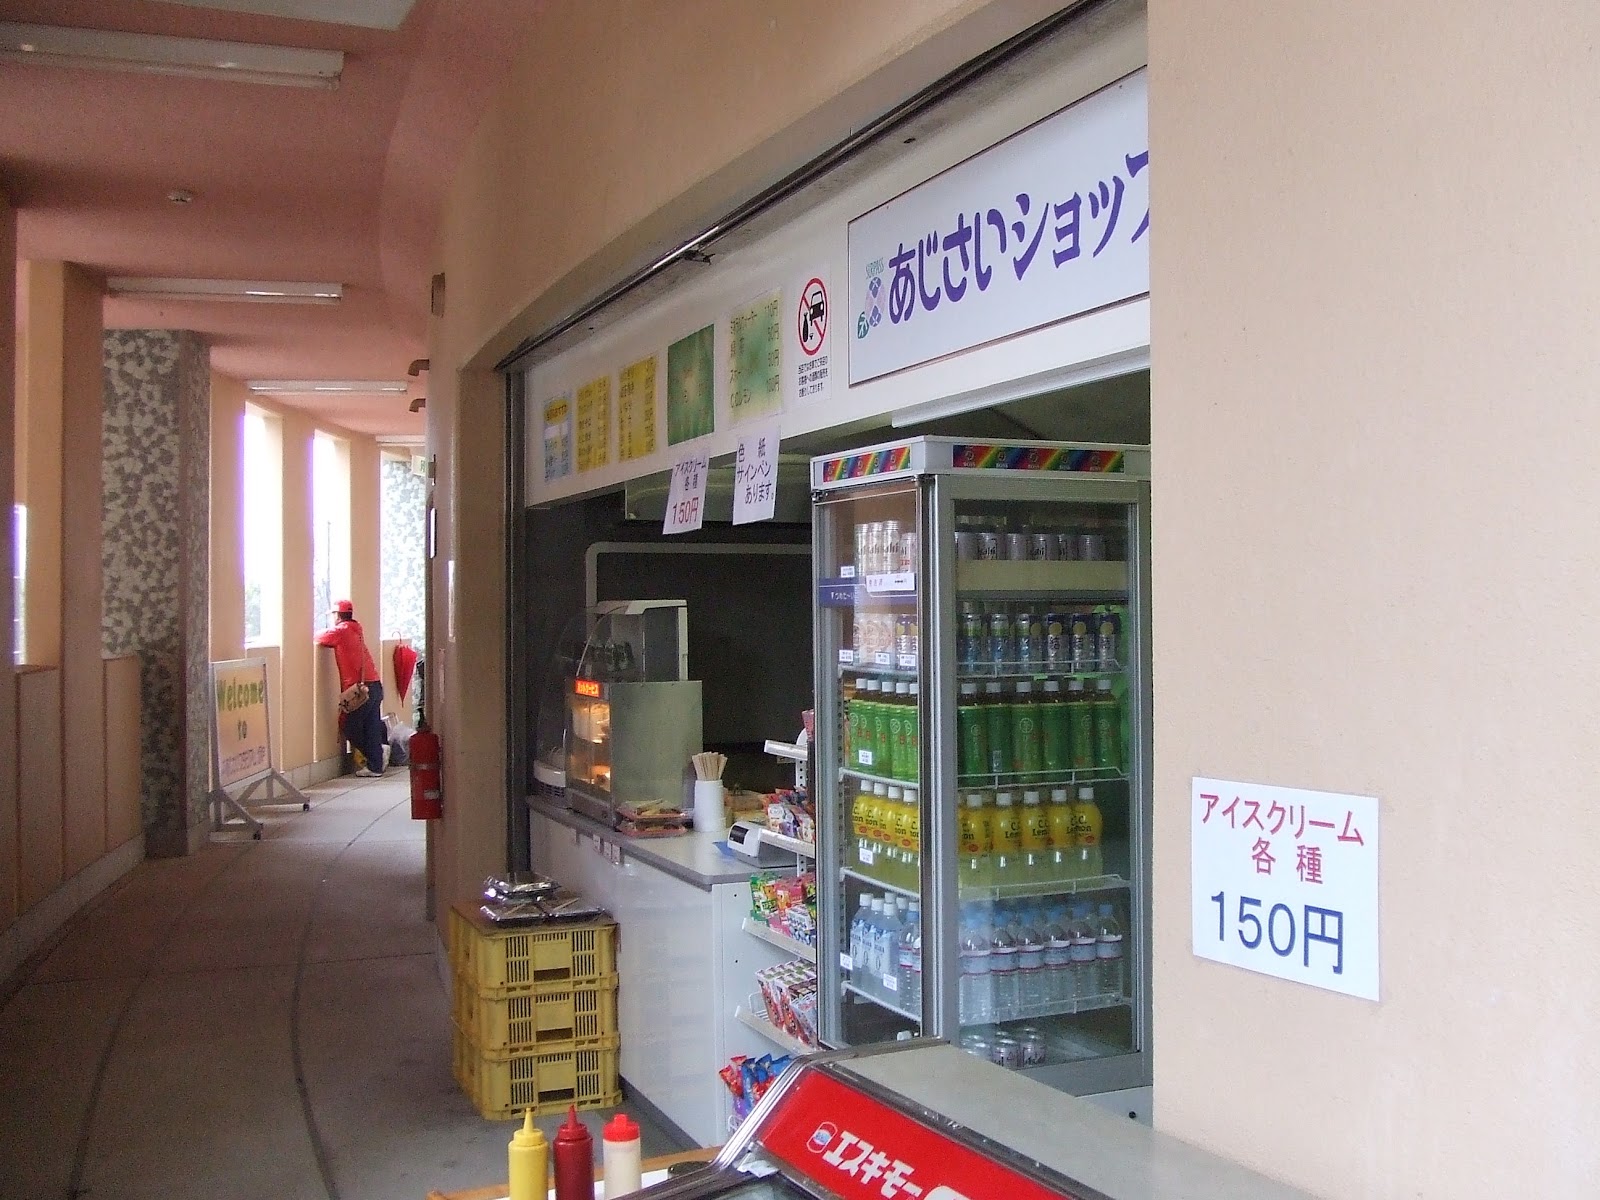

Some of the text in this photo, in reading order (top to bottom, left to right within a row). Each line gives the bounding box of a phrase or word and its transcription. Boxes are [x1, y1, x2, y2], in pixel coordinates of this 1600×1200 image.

[674, 456, 707, 477] アイスクリーム
[671, 497, 700, 525] 150円
[217, 677, 264, 712] Welcome
[237, 719, 248, 741] to
[1199, 793, 1365, 847] アイスクリーム
[1210, 890, 1344, 976] 150円
[822, 1130, 923, 1199] エスキモー
